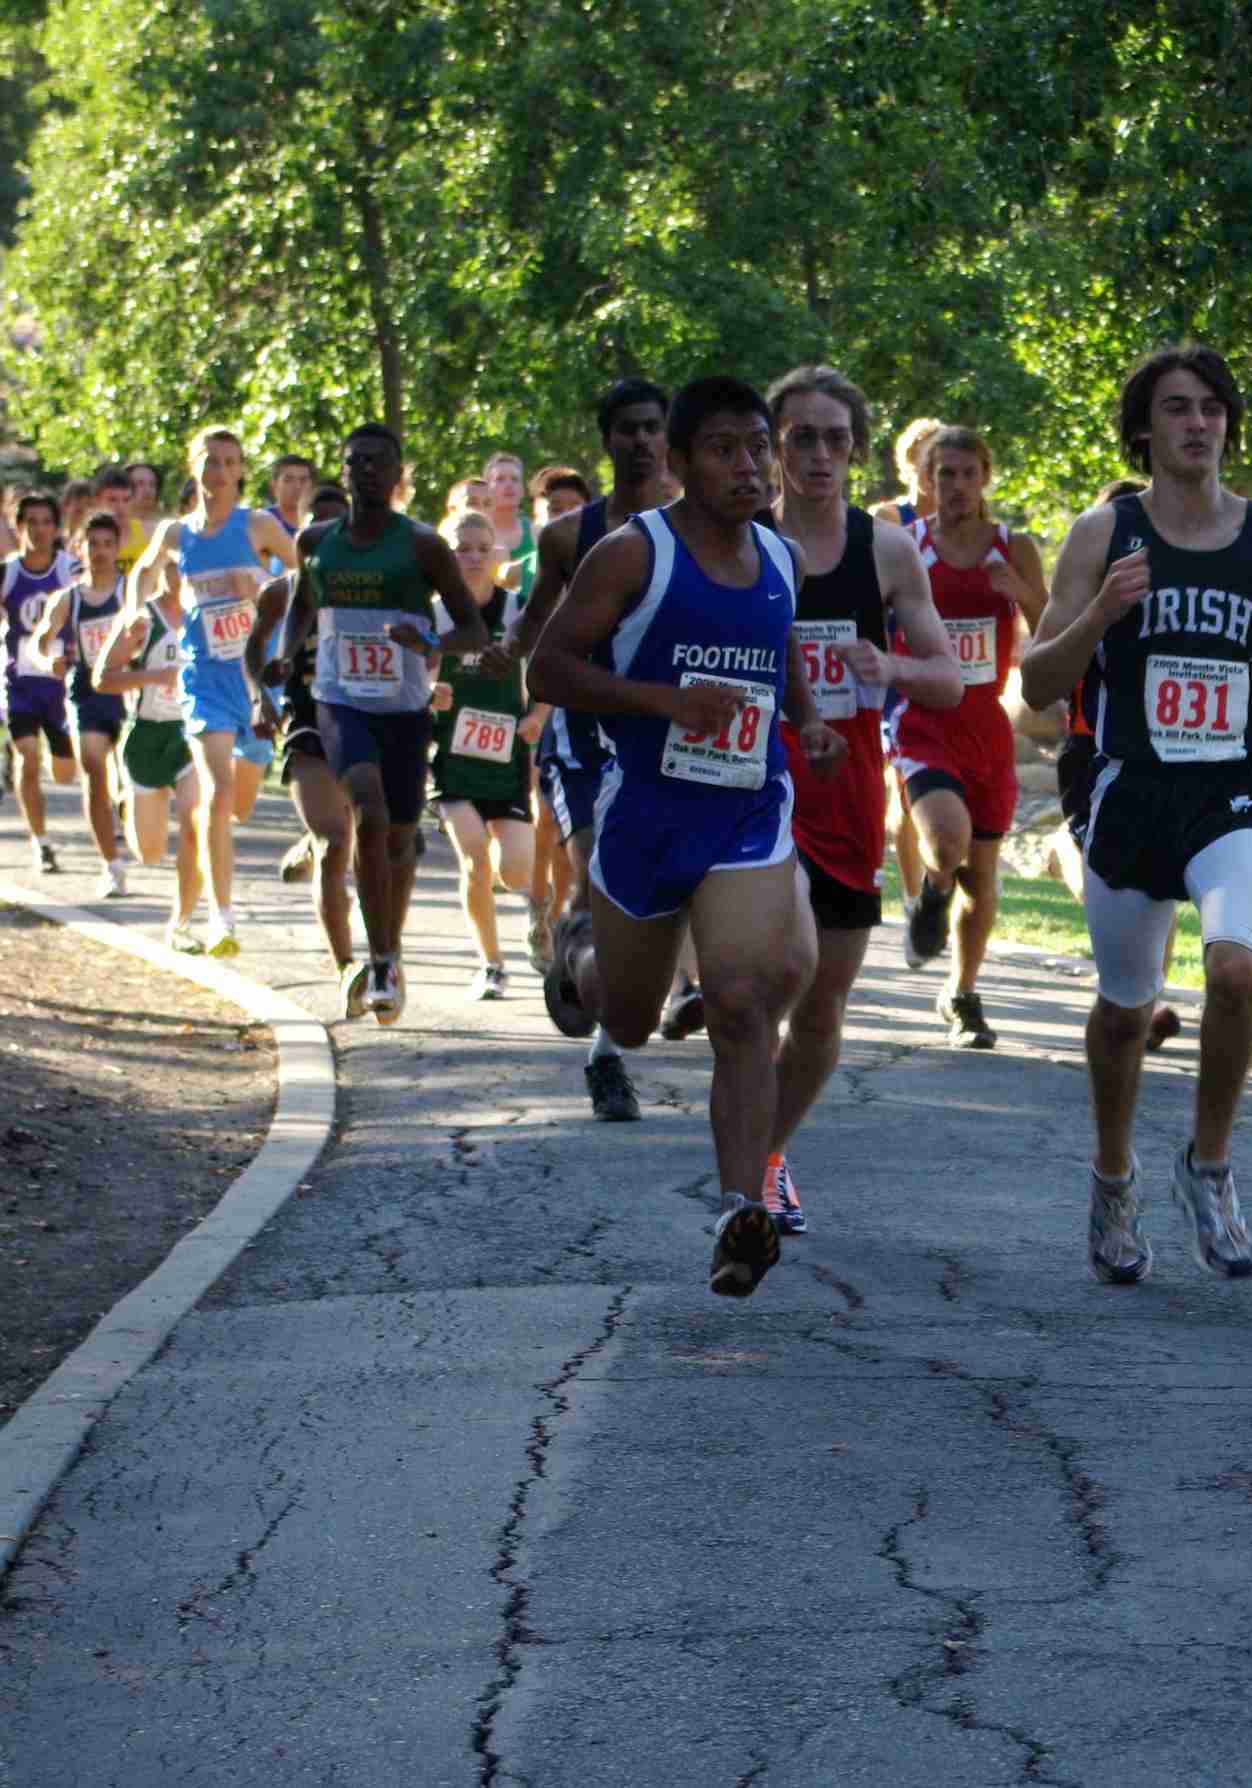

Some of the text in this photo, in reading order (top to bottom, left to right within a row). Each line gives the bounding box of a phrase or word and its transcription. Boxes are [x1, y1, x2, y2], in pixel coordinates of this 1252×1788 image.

[350, 643, 394, 673] 132
[672, 644, 777, 672] FOOTHILL
[1156, 680, 1229, 731] 831
[464, 720, 506, 752] 789
[682, 705, 761, 752] 18
